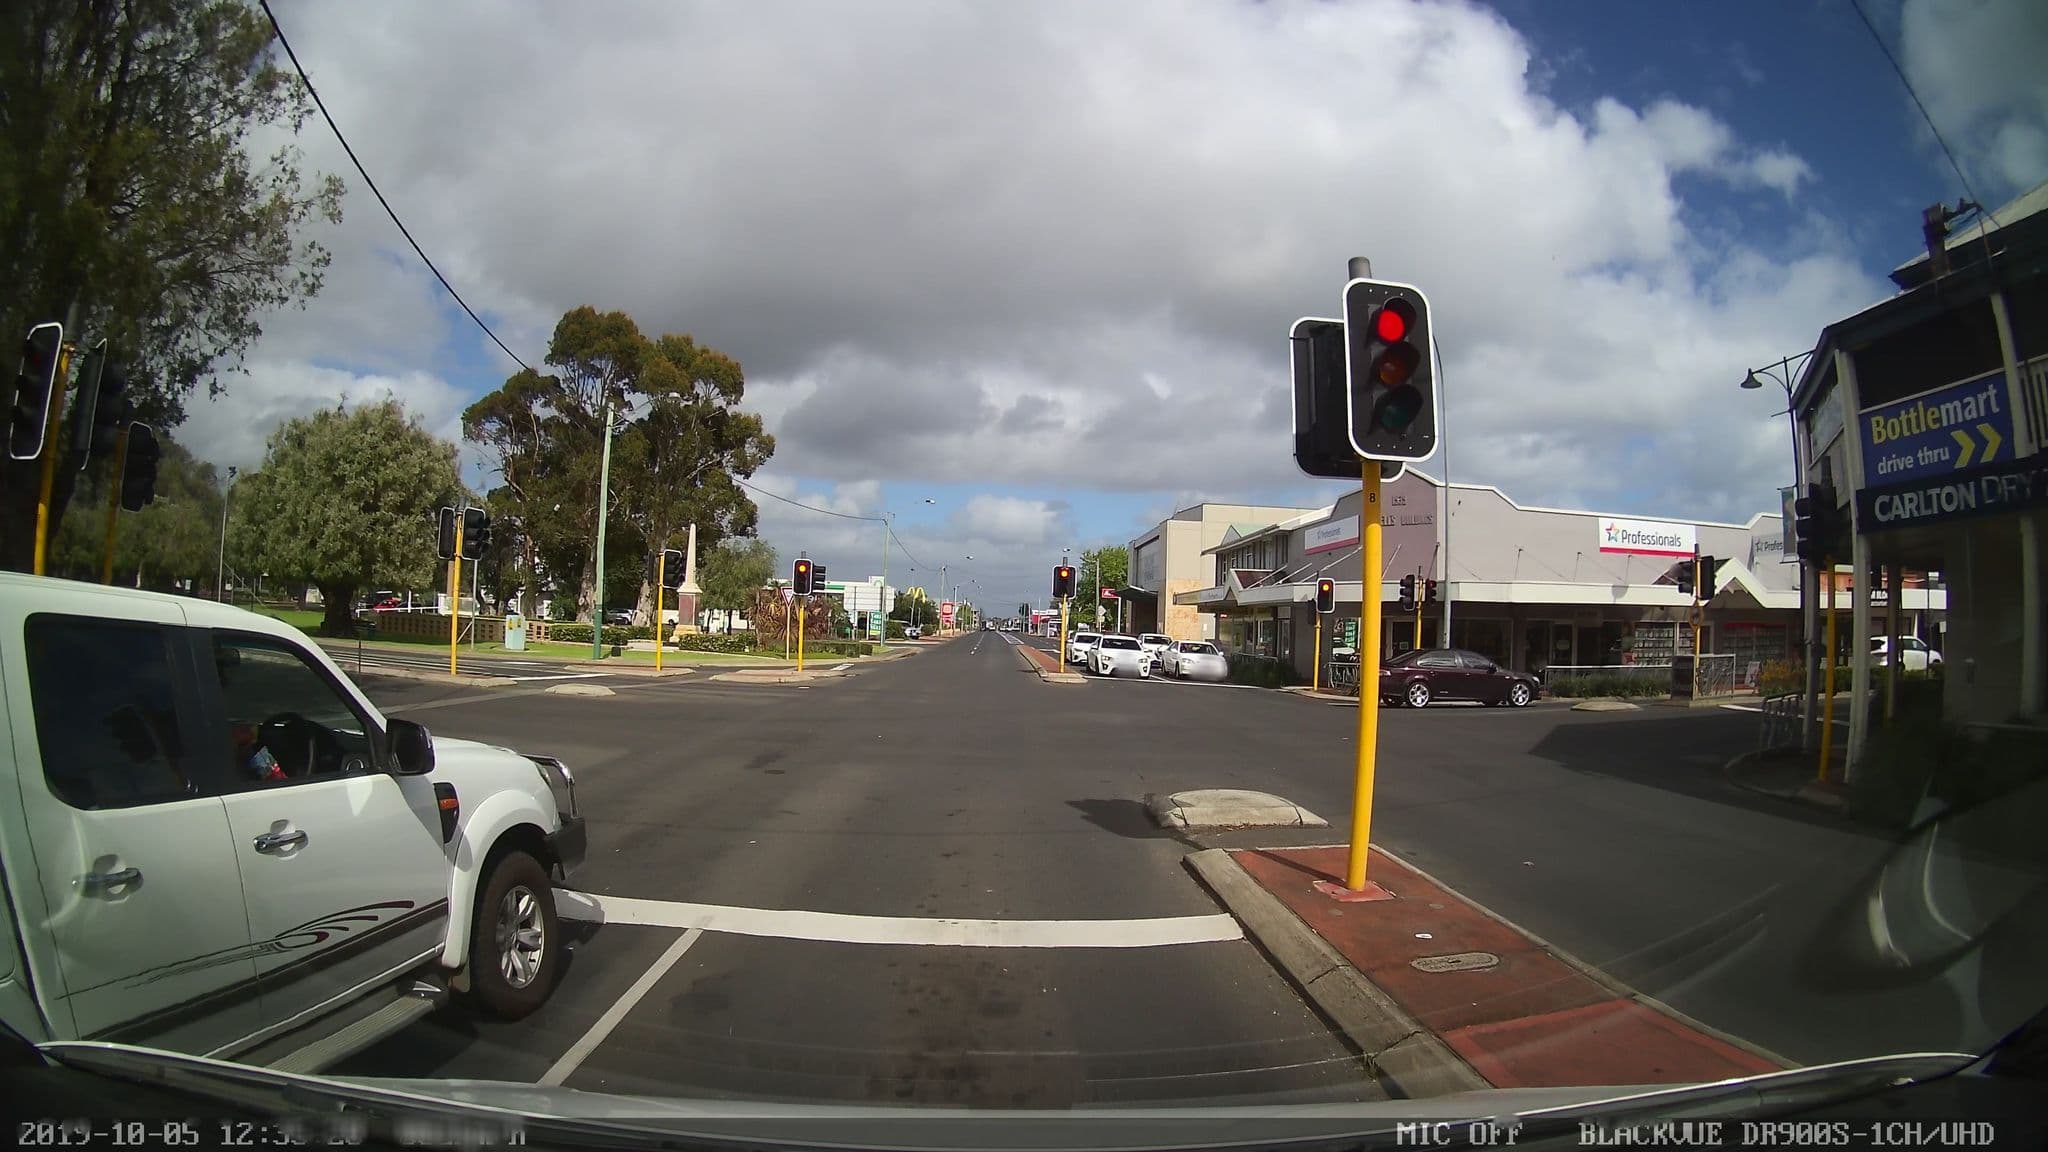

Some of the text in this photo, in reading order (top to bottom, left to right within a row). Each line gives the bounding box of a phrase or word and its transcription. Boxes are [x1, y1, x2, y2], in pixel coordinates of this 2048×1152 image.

[1871, 384, 1999, 445] Bottlemart
[1877, 446, 1950, 475] drive thru
[1369, 492, 1376, 503] 8
[1873, 481, 1976, 523] CARLTON
[1621, 529, 1682, 547] Professionals
